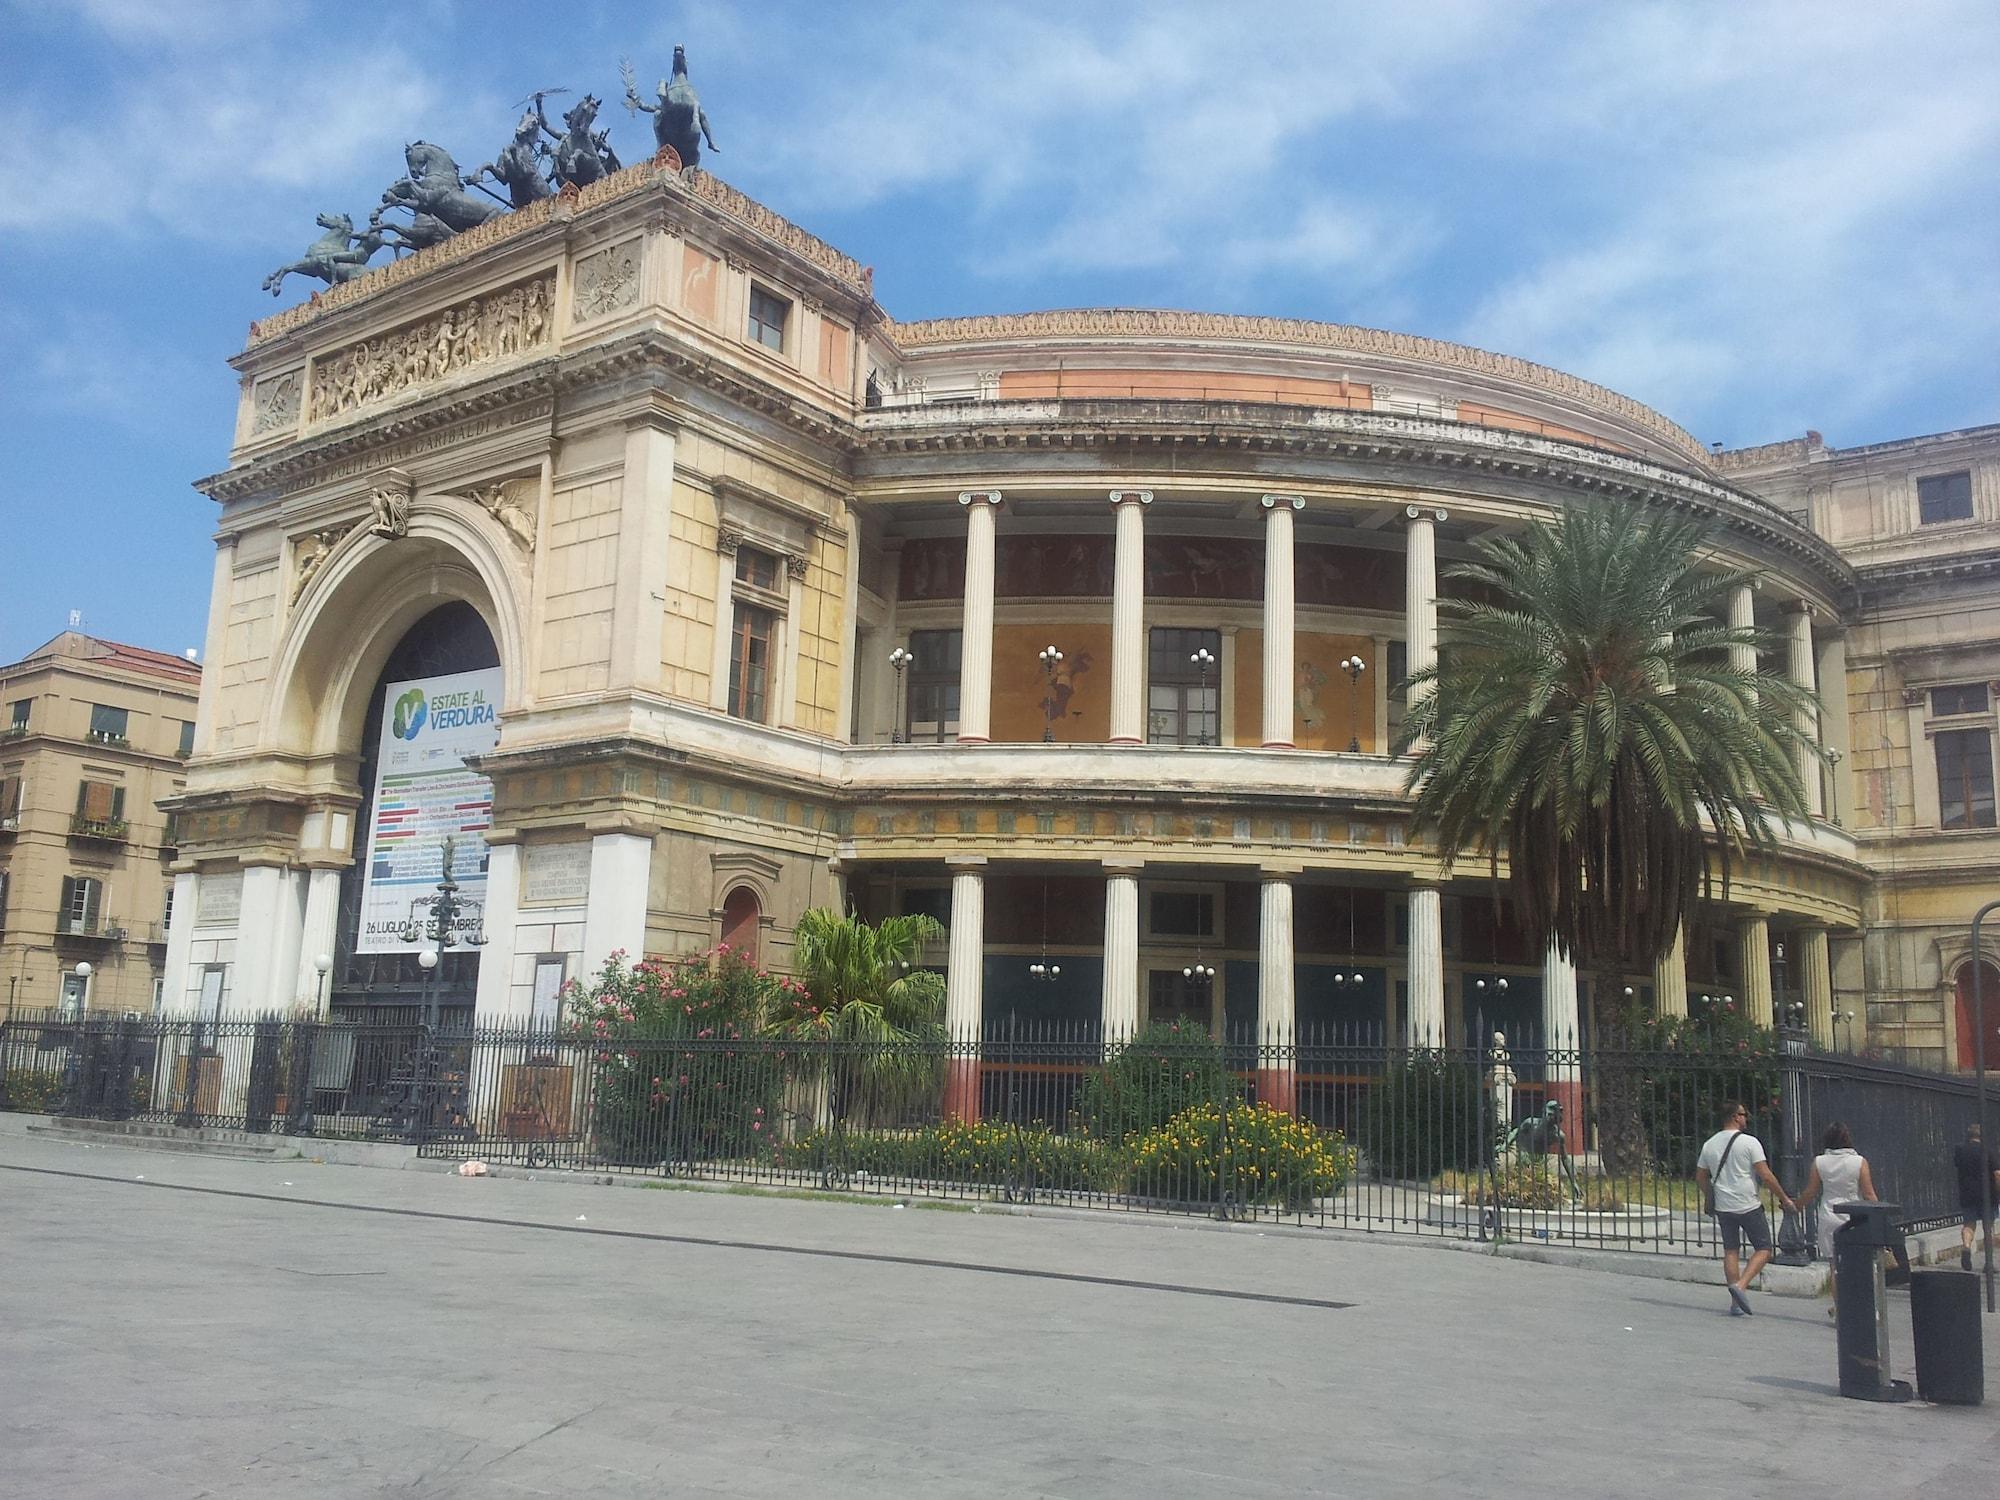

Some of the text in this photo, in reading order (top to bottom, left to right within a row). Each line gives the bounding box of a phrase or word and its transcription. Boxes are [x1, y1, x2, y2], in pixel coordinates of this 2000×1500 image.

[331, 418, 490, 480] POLITEAMA GARIBALDI
[431, 689, 486, 711] ESTATE AL
[430, 704, 494, 730] VERDURA
[366, 922, 376, 934] 26
[377, 920, 407, 933] LUGLIO
